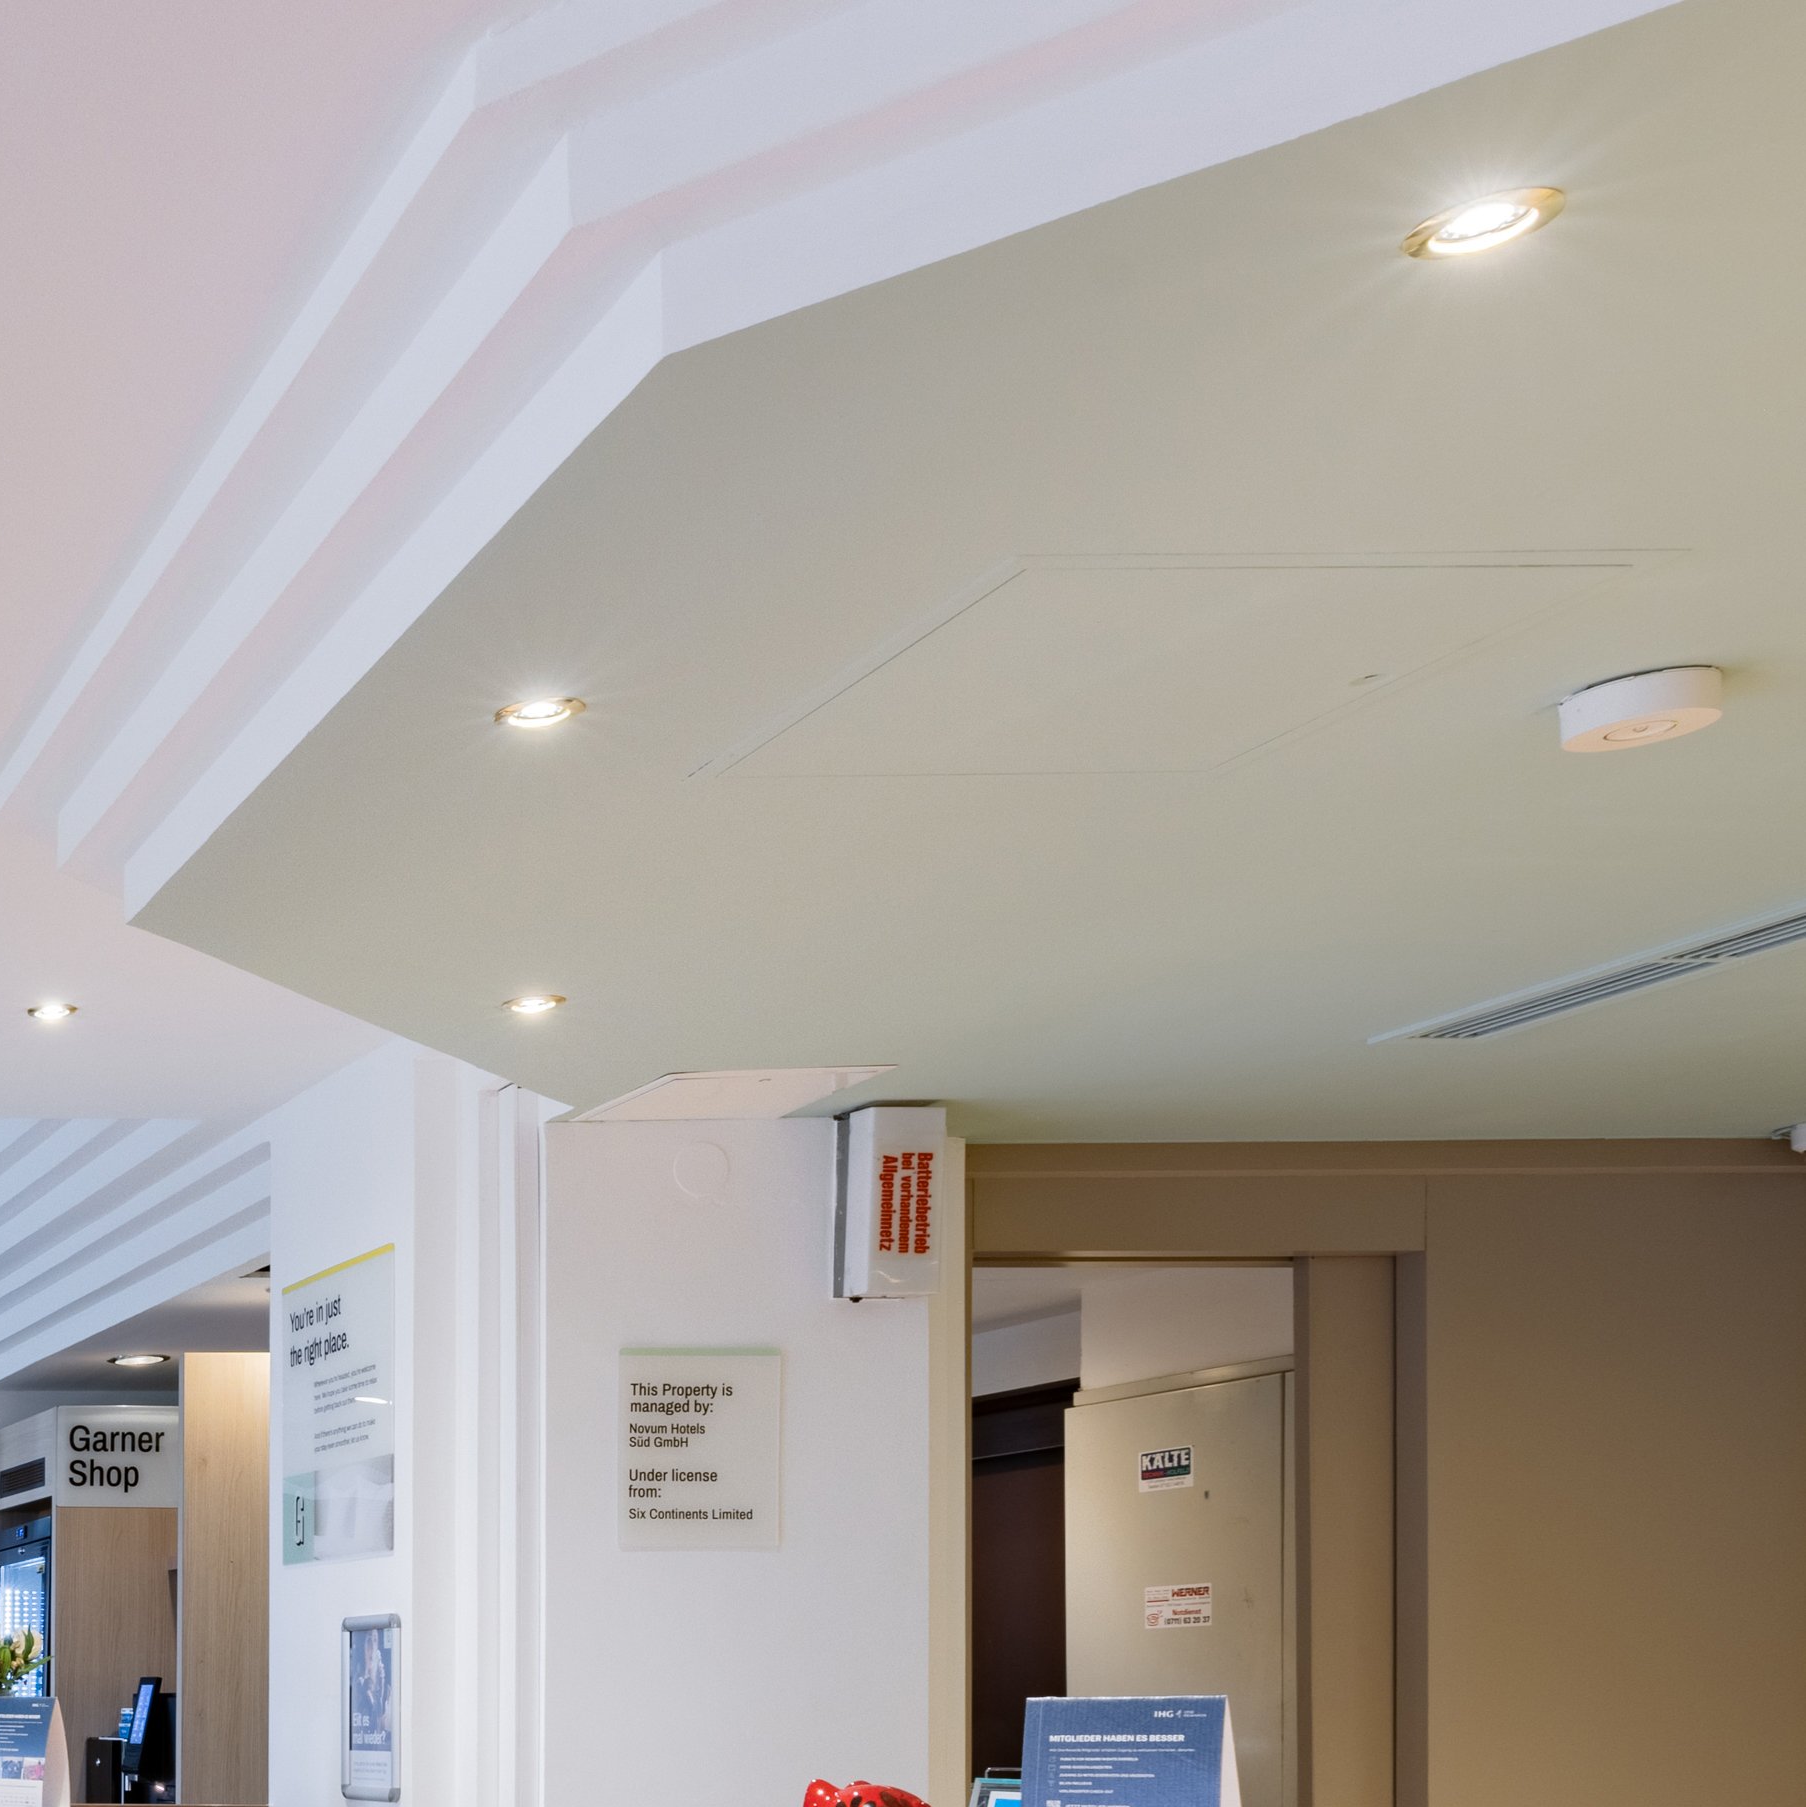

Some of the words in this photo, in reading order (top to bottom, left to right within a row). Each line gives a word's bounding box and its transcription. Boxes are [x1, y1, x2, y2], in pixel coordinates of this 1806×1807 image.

[901, 1152, 916, 1170] bei
[879, 1154, 898, 1251] Allgemeinnetz
[914, 1152, 934, 1255] Batteriebetrieb
[898, 1175, 913, 1253] vorhandenem
[289, 1307, 314, 1333] You're
[316, 1301, 324, 1323] in
[325, 1294, 341, 1326] just
[290, 1345, 303, 1368] the
[304, 1337, 322, 1366] right
[324, 1331, 349, 1361] place.
[630, 1383, 658, 1397] This
[662, 1383, 718, 1399] Property
[722, 1383, 733, 1397] is
[630, 1400, 690, 1416] managed
[694, 1400, 714, 1416] by:
[629, 1423, 668, 1435] Novum
[671, 1423, 706, 1435] Hotels
[69, 1425, 165, 1452] Garner
[629, 1436, 650, 1448] Süd
[654, 1436, 689, 1448] GmbH
[1142, 1449, 1190, 1471] KÄLTE
[68, 1459, 139, 1493] Shop
[629, 1469, 668, 1482] Under
[671, 1469, 718, 1482] license
[628, 1485, 662, 1498] from:
[628, 1508, 646, 1520] Six
[649, 1508, 709, 1520] Continents
[712, 1508, 753, 1520] Limited
[1172, 1586, 1210, 1597] WERNER
[1154, 1710, 1174, 1718] IHG
[1049, 1734, 1102, 1742] MITGLIEDER
[1103, 1734, 1135, 1742] HABEN
[1136, 1734, 1148, 1742] ES
[1149, 1734, 1185, 1742] BESSER
